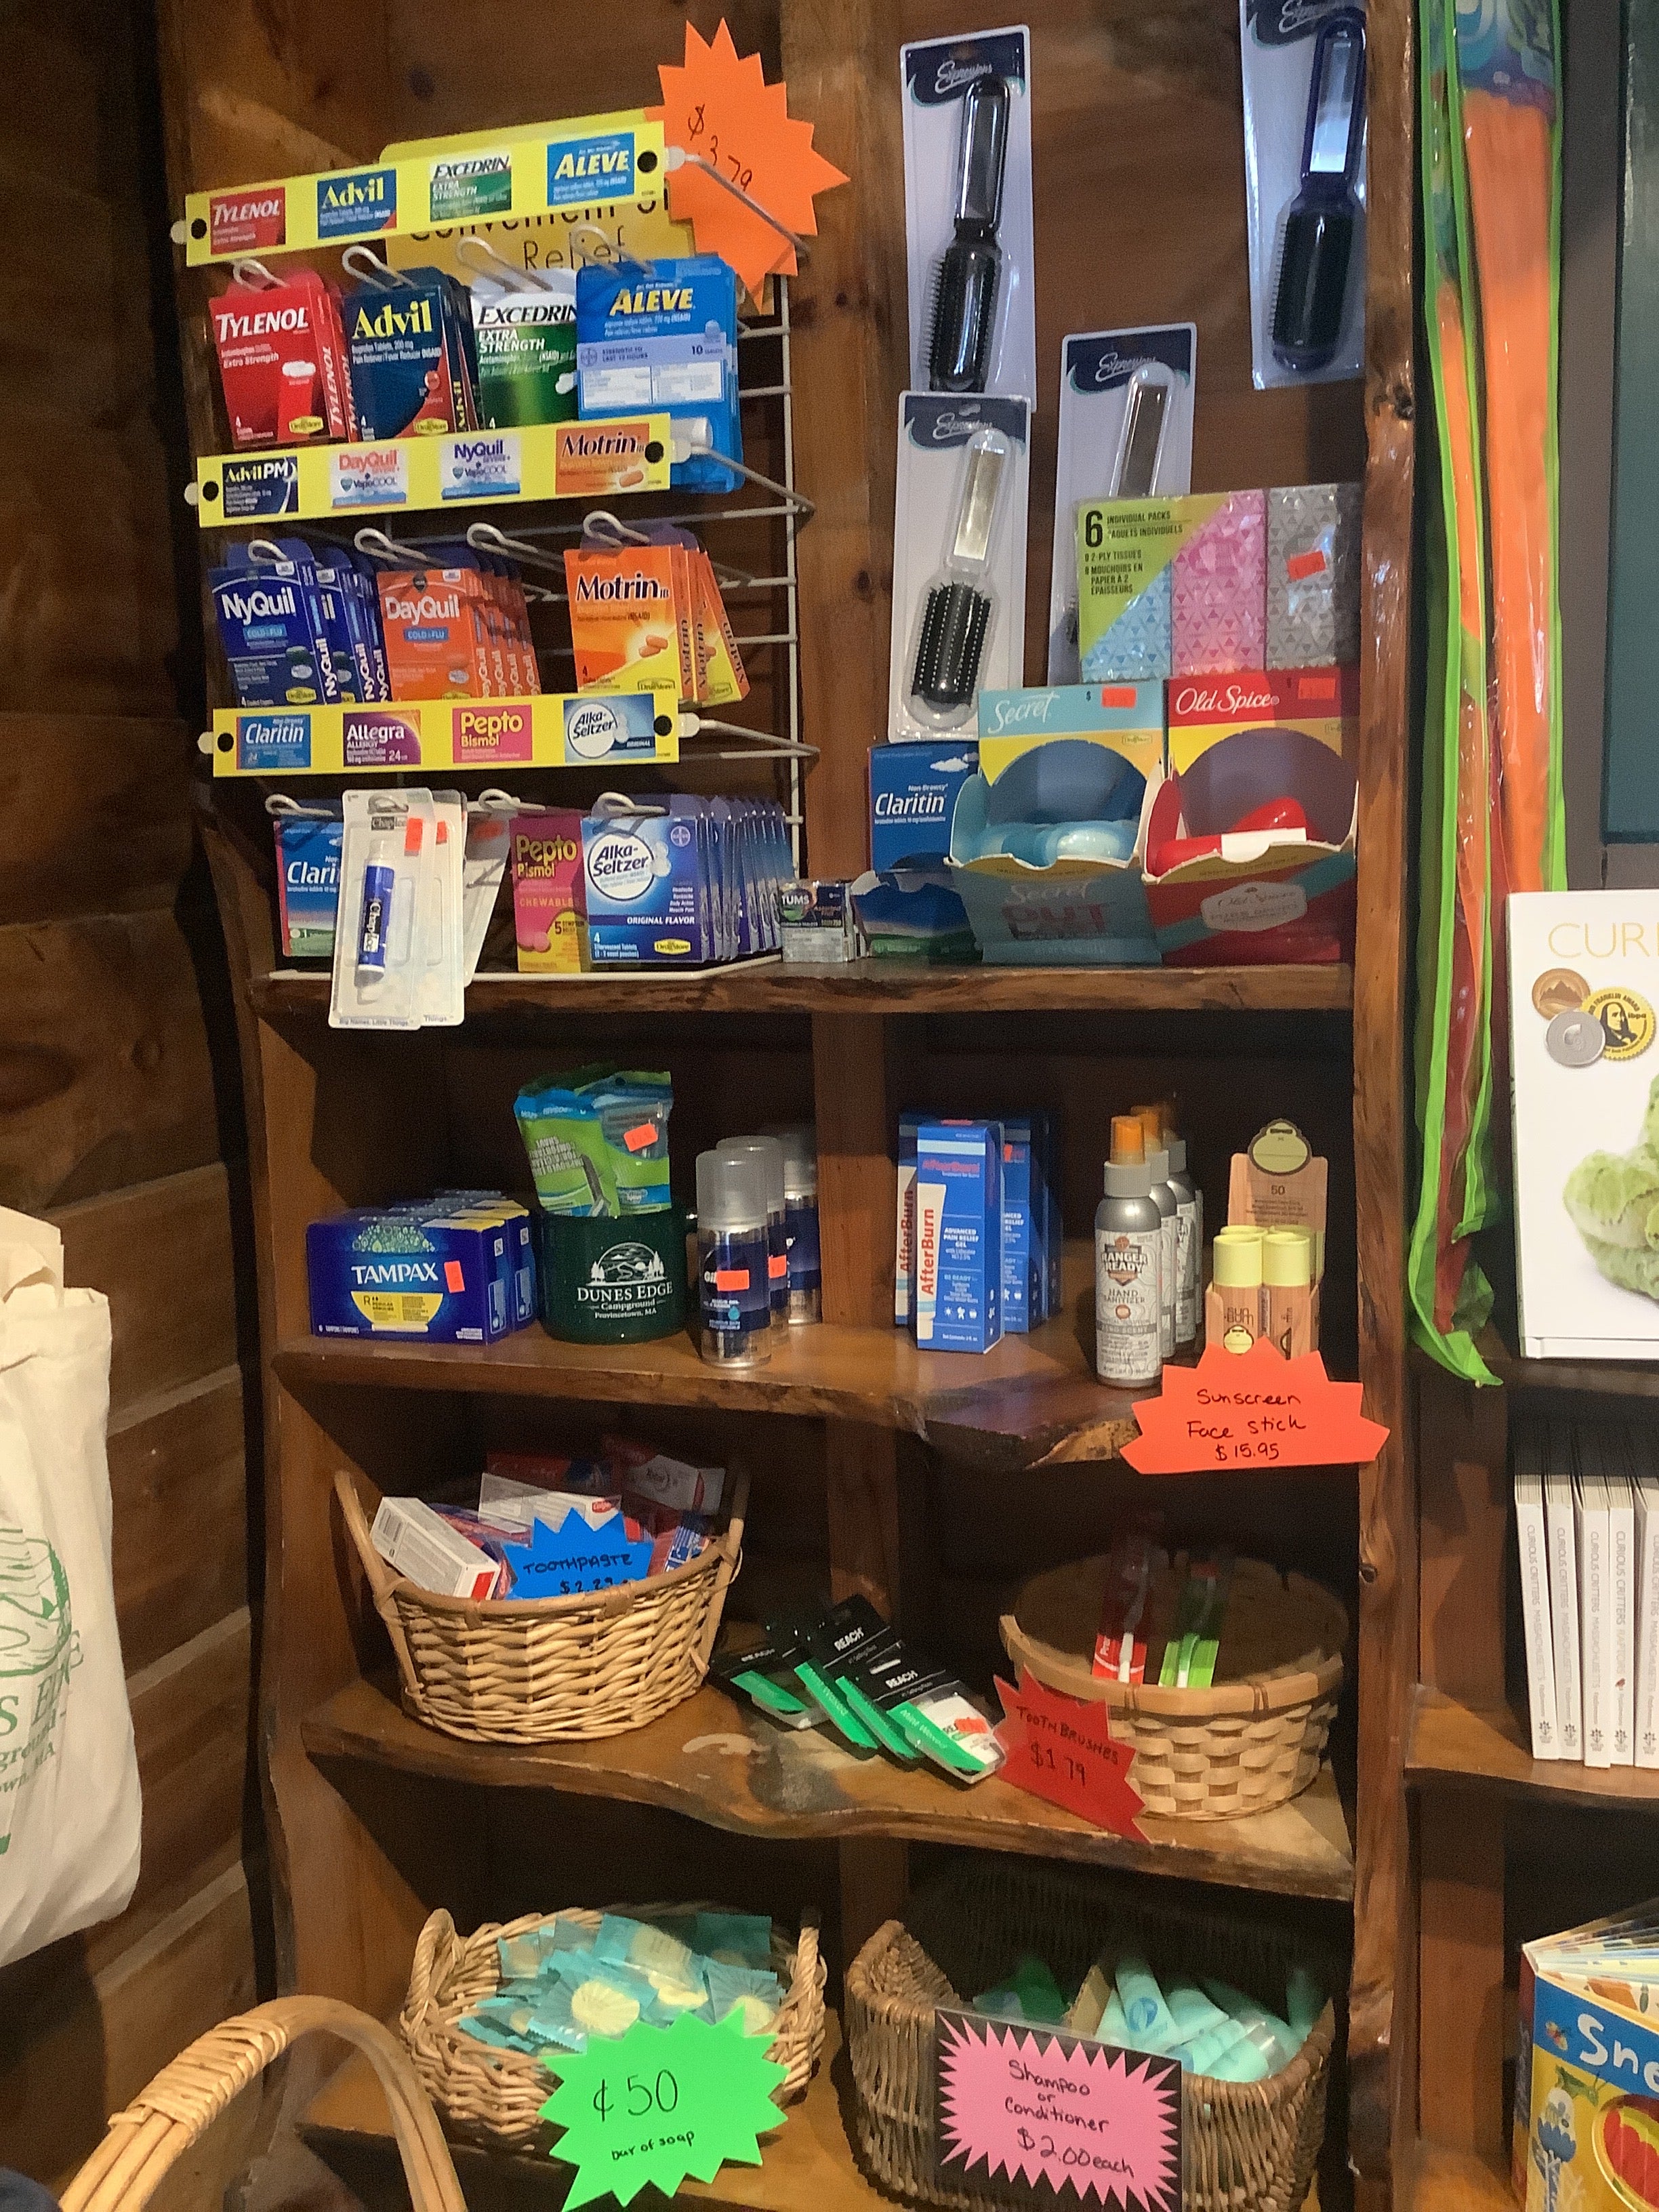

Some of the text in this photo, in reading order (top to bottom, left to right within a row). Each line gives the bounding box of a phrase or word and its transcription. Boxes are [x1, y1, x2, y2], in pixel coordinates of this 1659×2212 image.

[432, 155, 510, 180] EXCEDRIN
[555, 150, 630, 180] ALEVE
[321, 177, 384, 209] Advil
[432, 186, 478, 202] STRENGTH
[213, 199, 281, 226] TYLENOL
[524, 225, 626, 270] Relief
[609, 288, 695, 318] ALEVE
[216, 306, 310, 342] TYLENOL
[352, 300, 433, 340] Advil
[478, 304, 577, 325] EXCEDRIN
[478, 329, 518, 342] EXTRA
[478, 338, 546, 354] STRENGTH
[691, 344, 703, 356] 10
[454, 439, 504, 463] NyQuil
[562, 432, 637, 458] Motrin
[340, 449, 398, 474] DayQuil
[1107, 510, 1171, 525] INDIVIDUAL PACKS
[1086, 510, 1103, 548] 6
[1139, 525, 1183, 536] INDIVIDUELS
[1113, 549, 1142, 560] TISSUES
[1091, 562, 1143, 575] MOUCHOIRS EN
[576, 571, 660, 602] Motrin
[1091, 575, 1116, 585] PAPIER
[1124, 574, 1130, 583] 2
[222, 586, 297, 626] NyQuil
[385, 594, 461, 626] DayQuil
[476, 647, 493, 699] ayQuil
[1176, 685, 1273, 716] Old Spice
[577, 712, 607, 726] Alka-
[987, 691, 1061, 734] Secret
[245, 722, 305, 745] Claritin
[461, 710, 523, 737] Pepto
[573, 720, 615, 740] Seltzer
[347, 724, 405, 745] Allegra
[461, 734, 500, 747] Bismol
[875, 793, 945, 817] Claritin
[516, 834, 577, 867] Pepto
[596, 844, 638, 863] Alka-
[287, 861, 336, 884] Clari
[593, 857, 649, 877] Seltzer
[519, 897, 575, 907] CHEWABLE
[781, 893, 810, 906] TUMS
[554, 921, 562, 935] 5
[627, 916, 695, 925] ORIGINAL FLAVOR
[594, 932, 600, 944] 4
[1271, 1185, 1286, 1195] 50
[899, 1189, 914, 1273] AfterBurn
[944, 1227, 977, 1235] ADVANCED
[922, 1208, 934, 1296] AfterBurn
[1101, 1252, 1147, 1265] RANGER
[351, 1262, 438, 1285] TAMPAX
[1105, 1262, 1145, 1273] READY
[363, 1295, 371, 1306] R
[577, 1282, 673, 1302] DUNES EDGE
[1108, 1288, 1139, 1297] HAND
[601, 1298, 655, 1311] Campground
[1197, 1389, 1301, 1406] Sunscreen
[1187, 1420, 1234, 1439] Face
[523, 1553, 634, 1574] TOOTHPASTE
[1616, 1530, 1626, 1577] CURIOUS
[1616, 1578, 1626, 1626] CRITTERS
[834, 1626, 864, 1652] REACH
[885, 1670, 919, 1689] REACH
[1017, 1705, 1119, 1765] TOOTH BRUSHES
[1008, 2059, 1091, 2096] Shampoo
[1037, 2092, 1056, 2102] or
[1004, 2096, 1110, 2133] Conditioner
[612, 2131, 695, 2161] bar of soap
[1092, 2157, 1136, 2179] each
